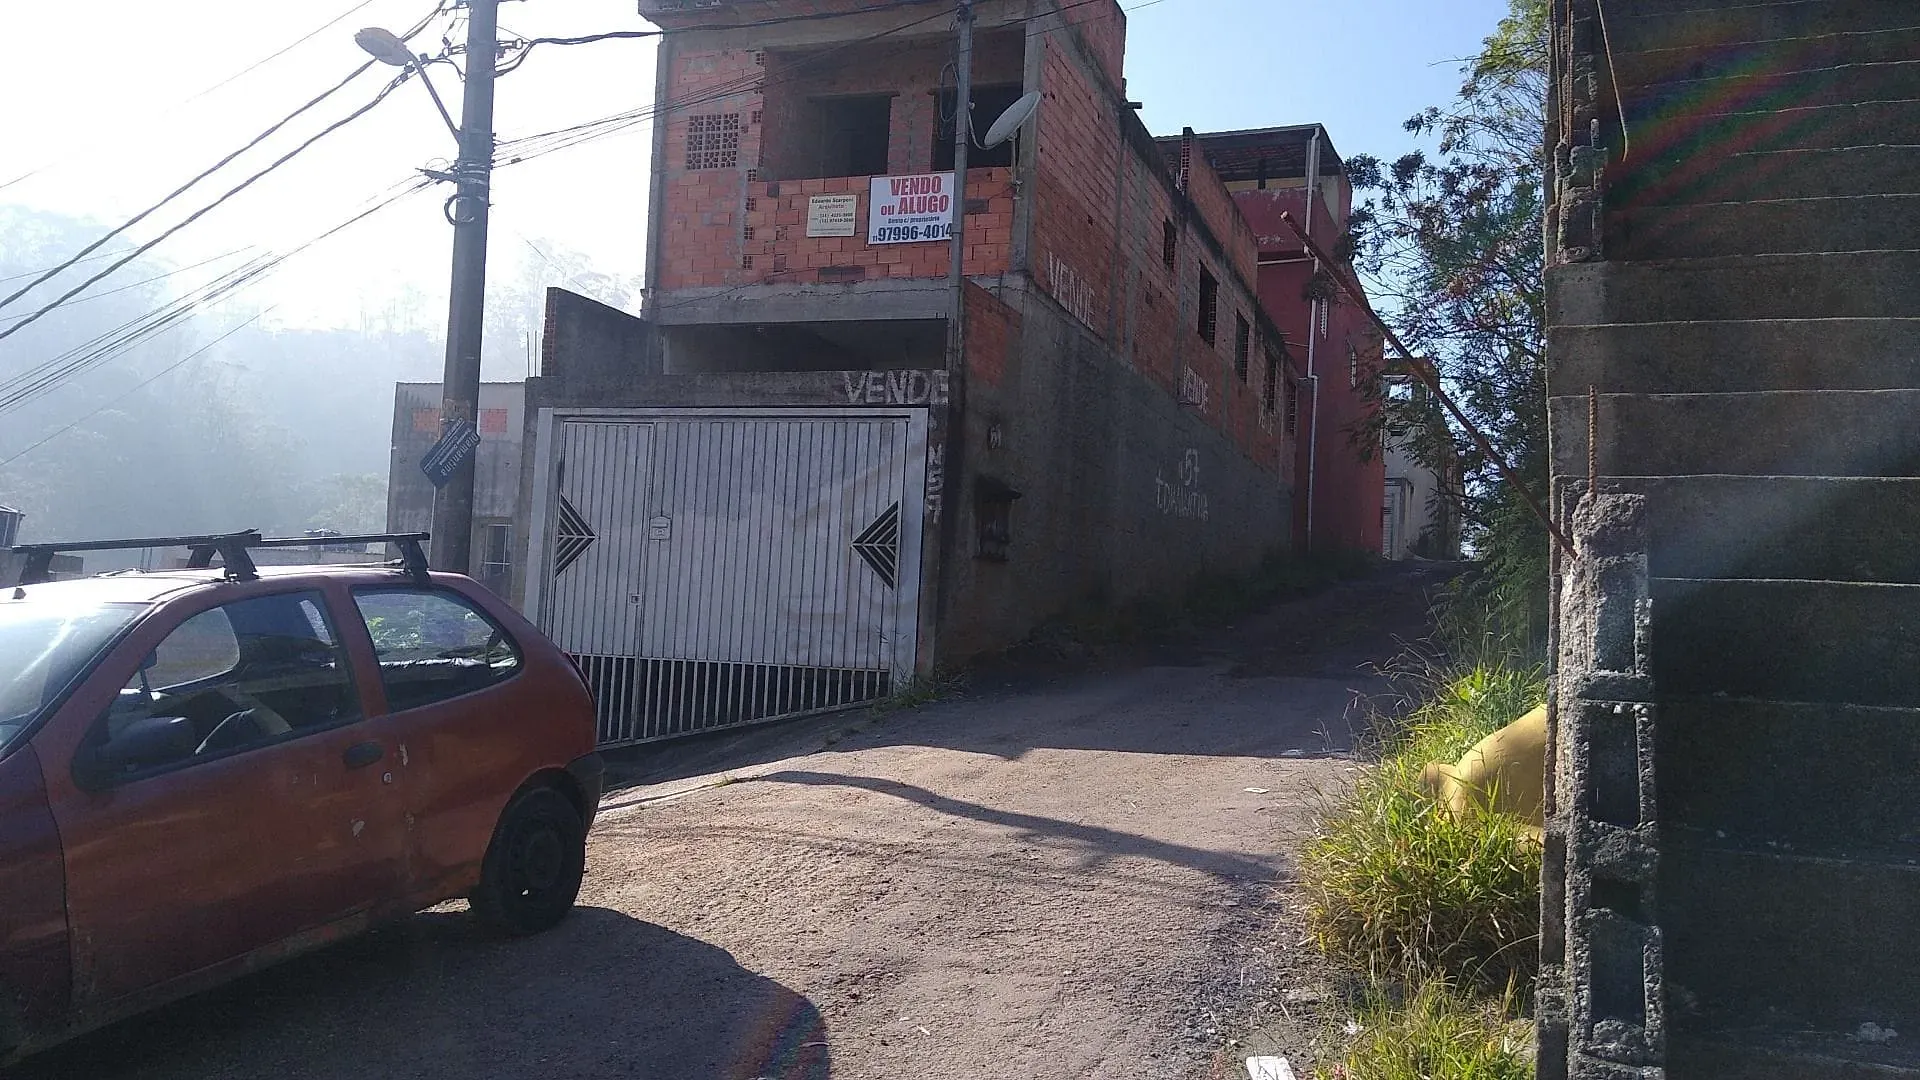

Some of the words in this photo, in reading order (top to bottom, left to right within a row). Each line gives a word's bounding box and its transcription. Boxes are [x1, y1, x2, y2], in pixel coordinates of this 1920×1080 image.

[890, 176, 942, 196] VENDO
[880, 205, 895, 215] OU
[898, 195, 949, 215] ALUGO
[1049, 251, 1095, 330] VENDE
[844, 369, 949, 404] VENDE
